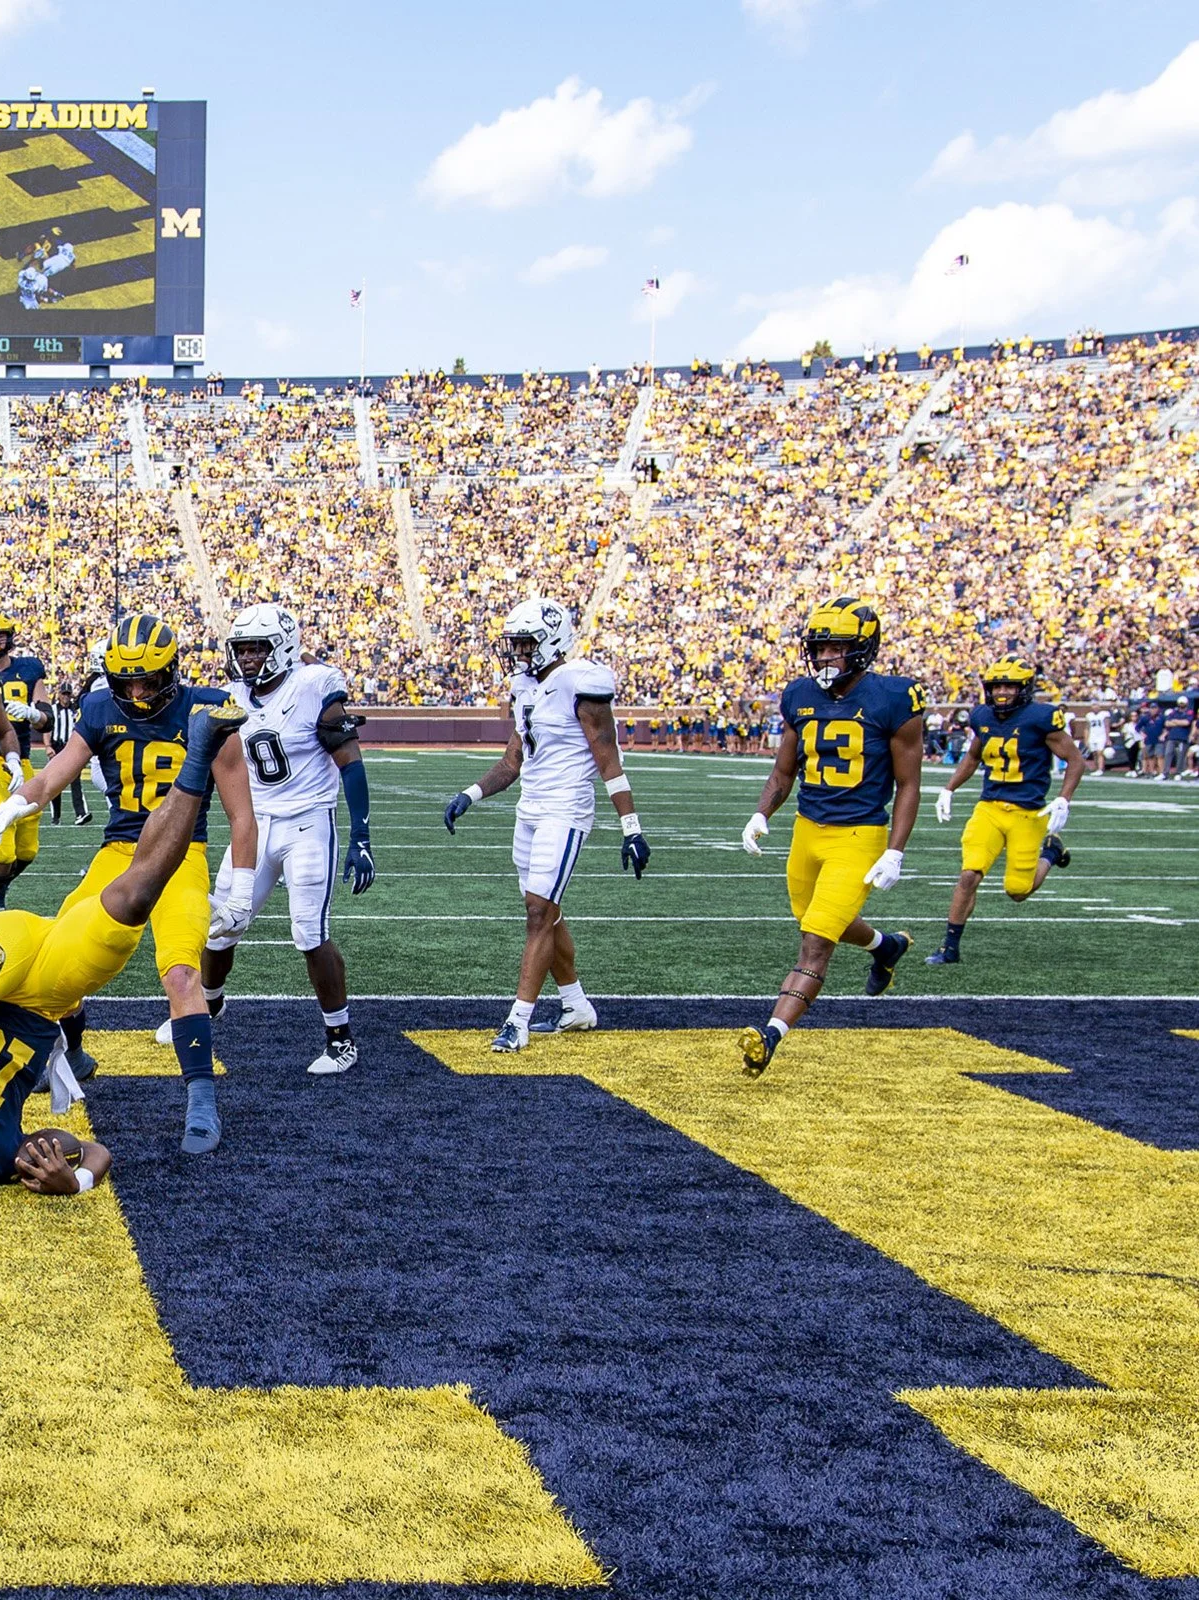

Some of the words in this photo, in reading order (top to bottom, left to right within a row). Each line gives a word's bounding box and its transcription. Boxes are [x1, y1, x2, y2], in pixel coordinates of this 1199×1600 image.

[160, 207, 202, 239] M
[33, 337, 64, 353] 4th
[102, 342, 124, 359] M
[178, 338, 202, 357] 40
[244, 728, 292, 787] 0
[801, 719, 865, 789] 13
[981, 736, 1024, 783] 41
[114, 739, 188, 813] 18
